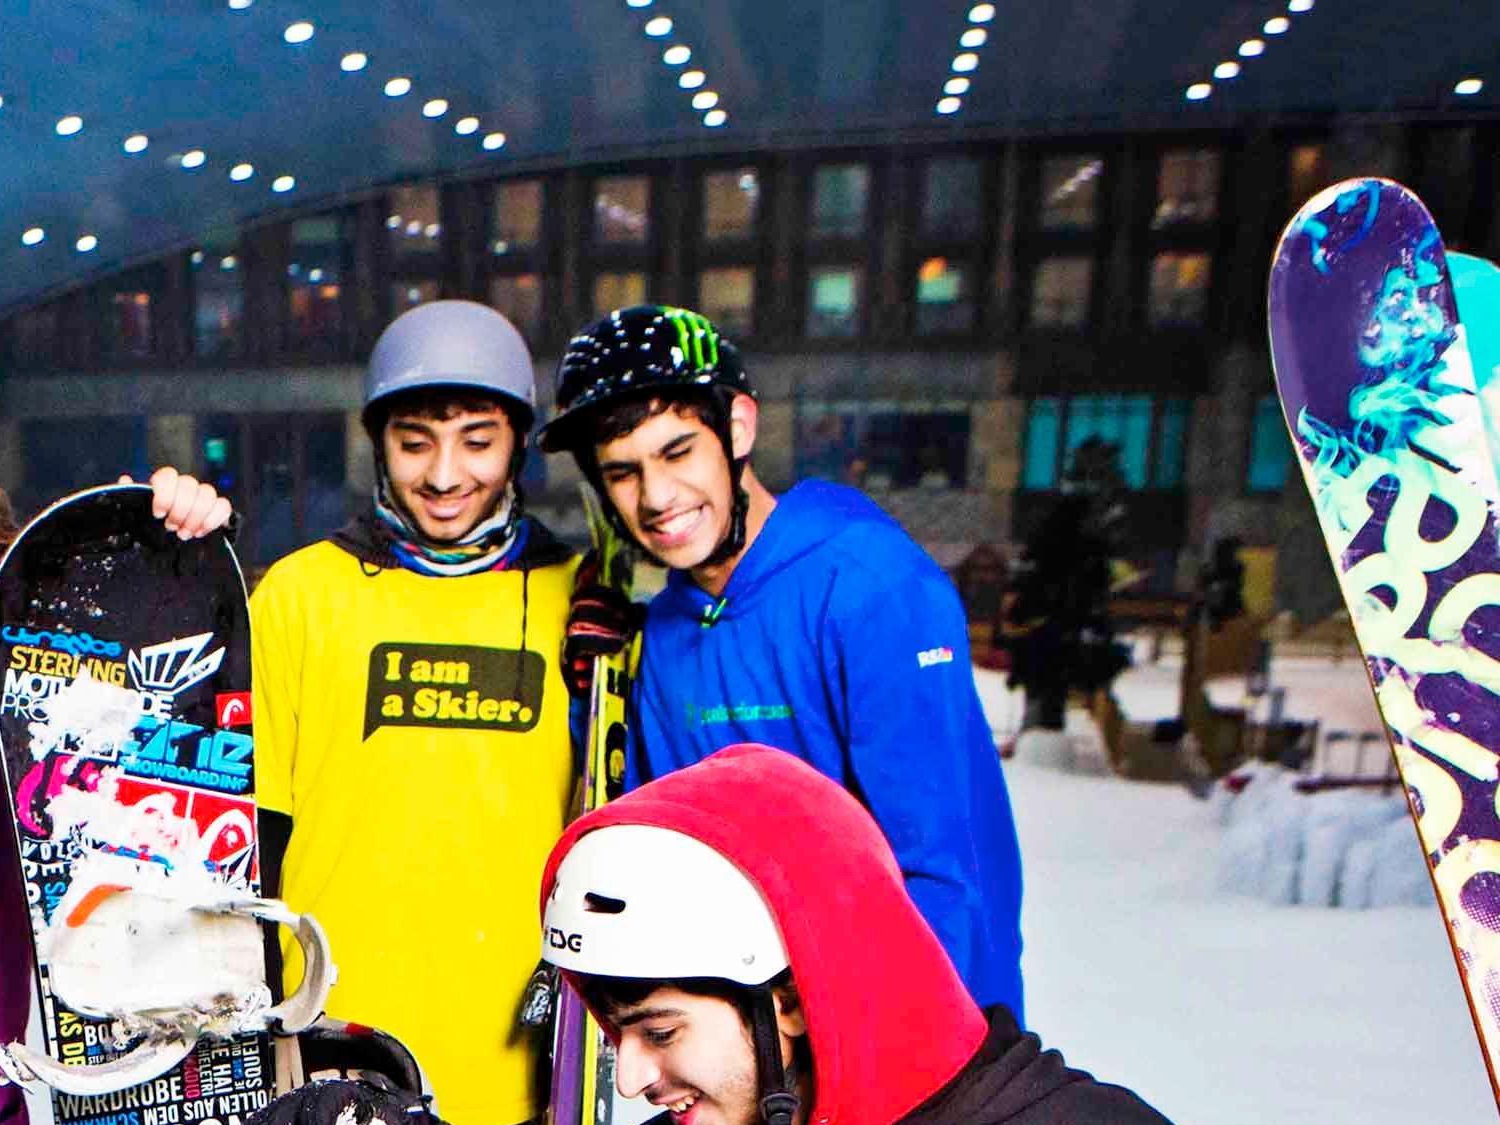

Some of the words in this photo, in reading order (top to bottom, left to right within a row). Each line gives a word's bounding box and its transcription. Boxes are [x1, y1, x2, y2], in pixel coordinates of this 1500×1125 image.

[10, 645, 126, 688] STERLING
[385, 651, 403, 681] I
[410, 660, 470, 684] am
[381, 694, 405, 718] a
[412, 688, 533, 723] Skier.
[60, 1075, 184, 1119] WARDROBE
[183, 1097, 215, 1121] AUS
[219, 1089, 273, 1116] OLLEN
